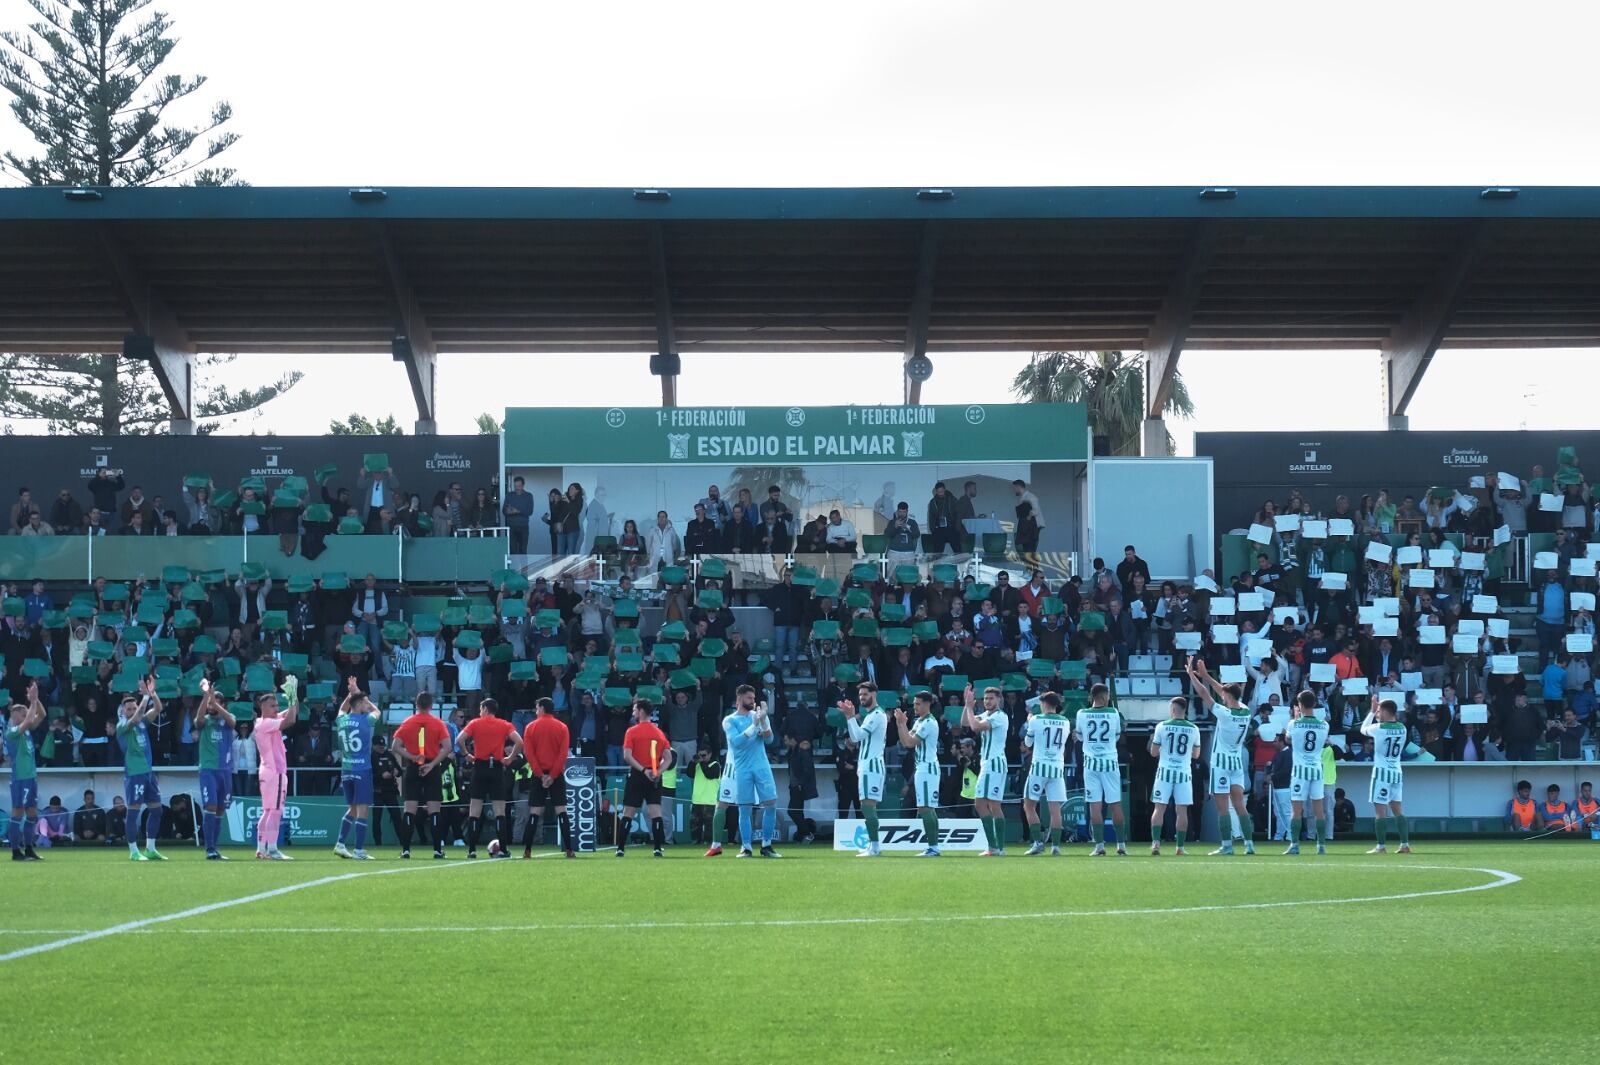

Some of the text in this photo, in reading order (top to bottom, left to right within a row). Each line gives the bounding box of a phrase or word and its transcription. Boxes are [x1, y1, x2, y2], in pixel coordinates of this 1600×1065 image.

[671, 406, 746, 427] FEDERACIÓN
[861, 405, 936, 425] FEDERACIÓN
[697, 434, 896, 456] ESTADIO EL PALMAR
[425, 459, 471, 469] EL PALMAR
[1443, 455, 1489, 464] EL PALMAR
[338, 729, 363, 752] 16
[1043, 726, 1063, 750] 14
[1086, 720, 1110, 742] 22
[1234, 723, 1247, 745] 7
[1304, 730, 1317, 752] 8
[1167, 732, 1189, 755] 18
[1384, 736, 1402, 758] 16
[23, 788, 30, 798] 7
[134, 784, 145, 795] 14
[246, 806, 302, 819] CEED
[578, 786, 594, 852] marco
